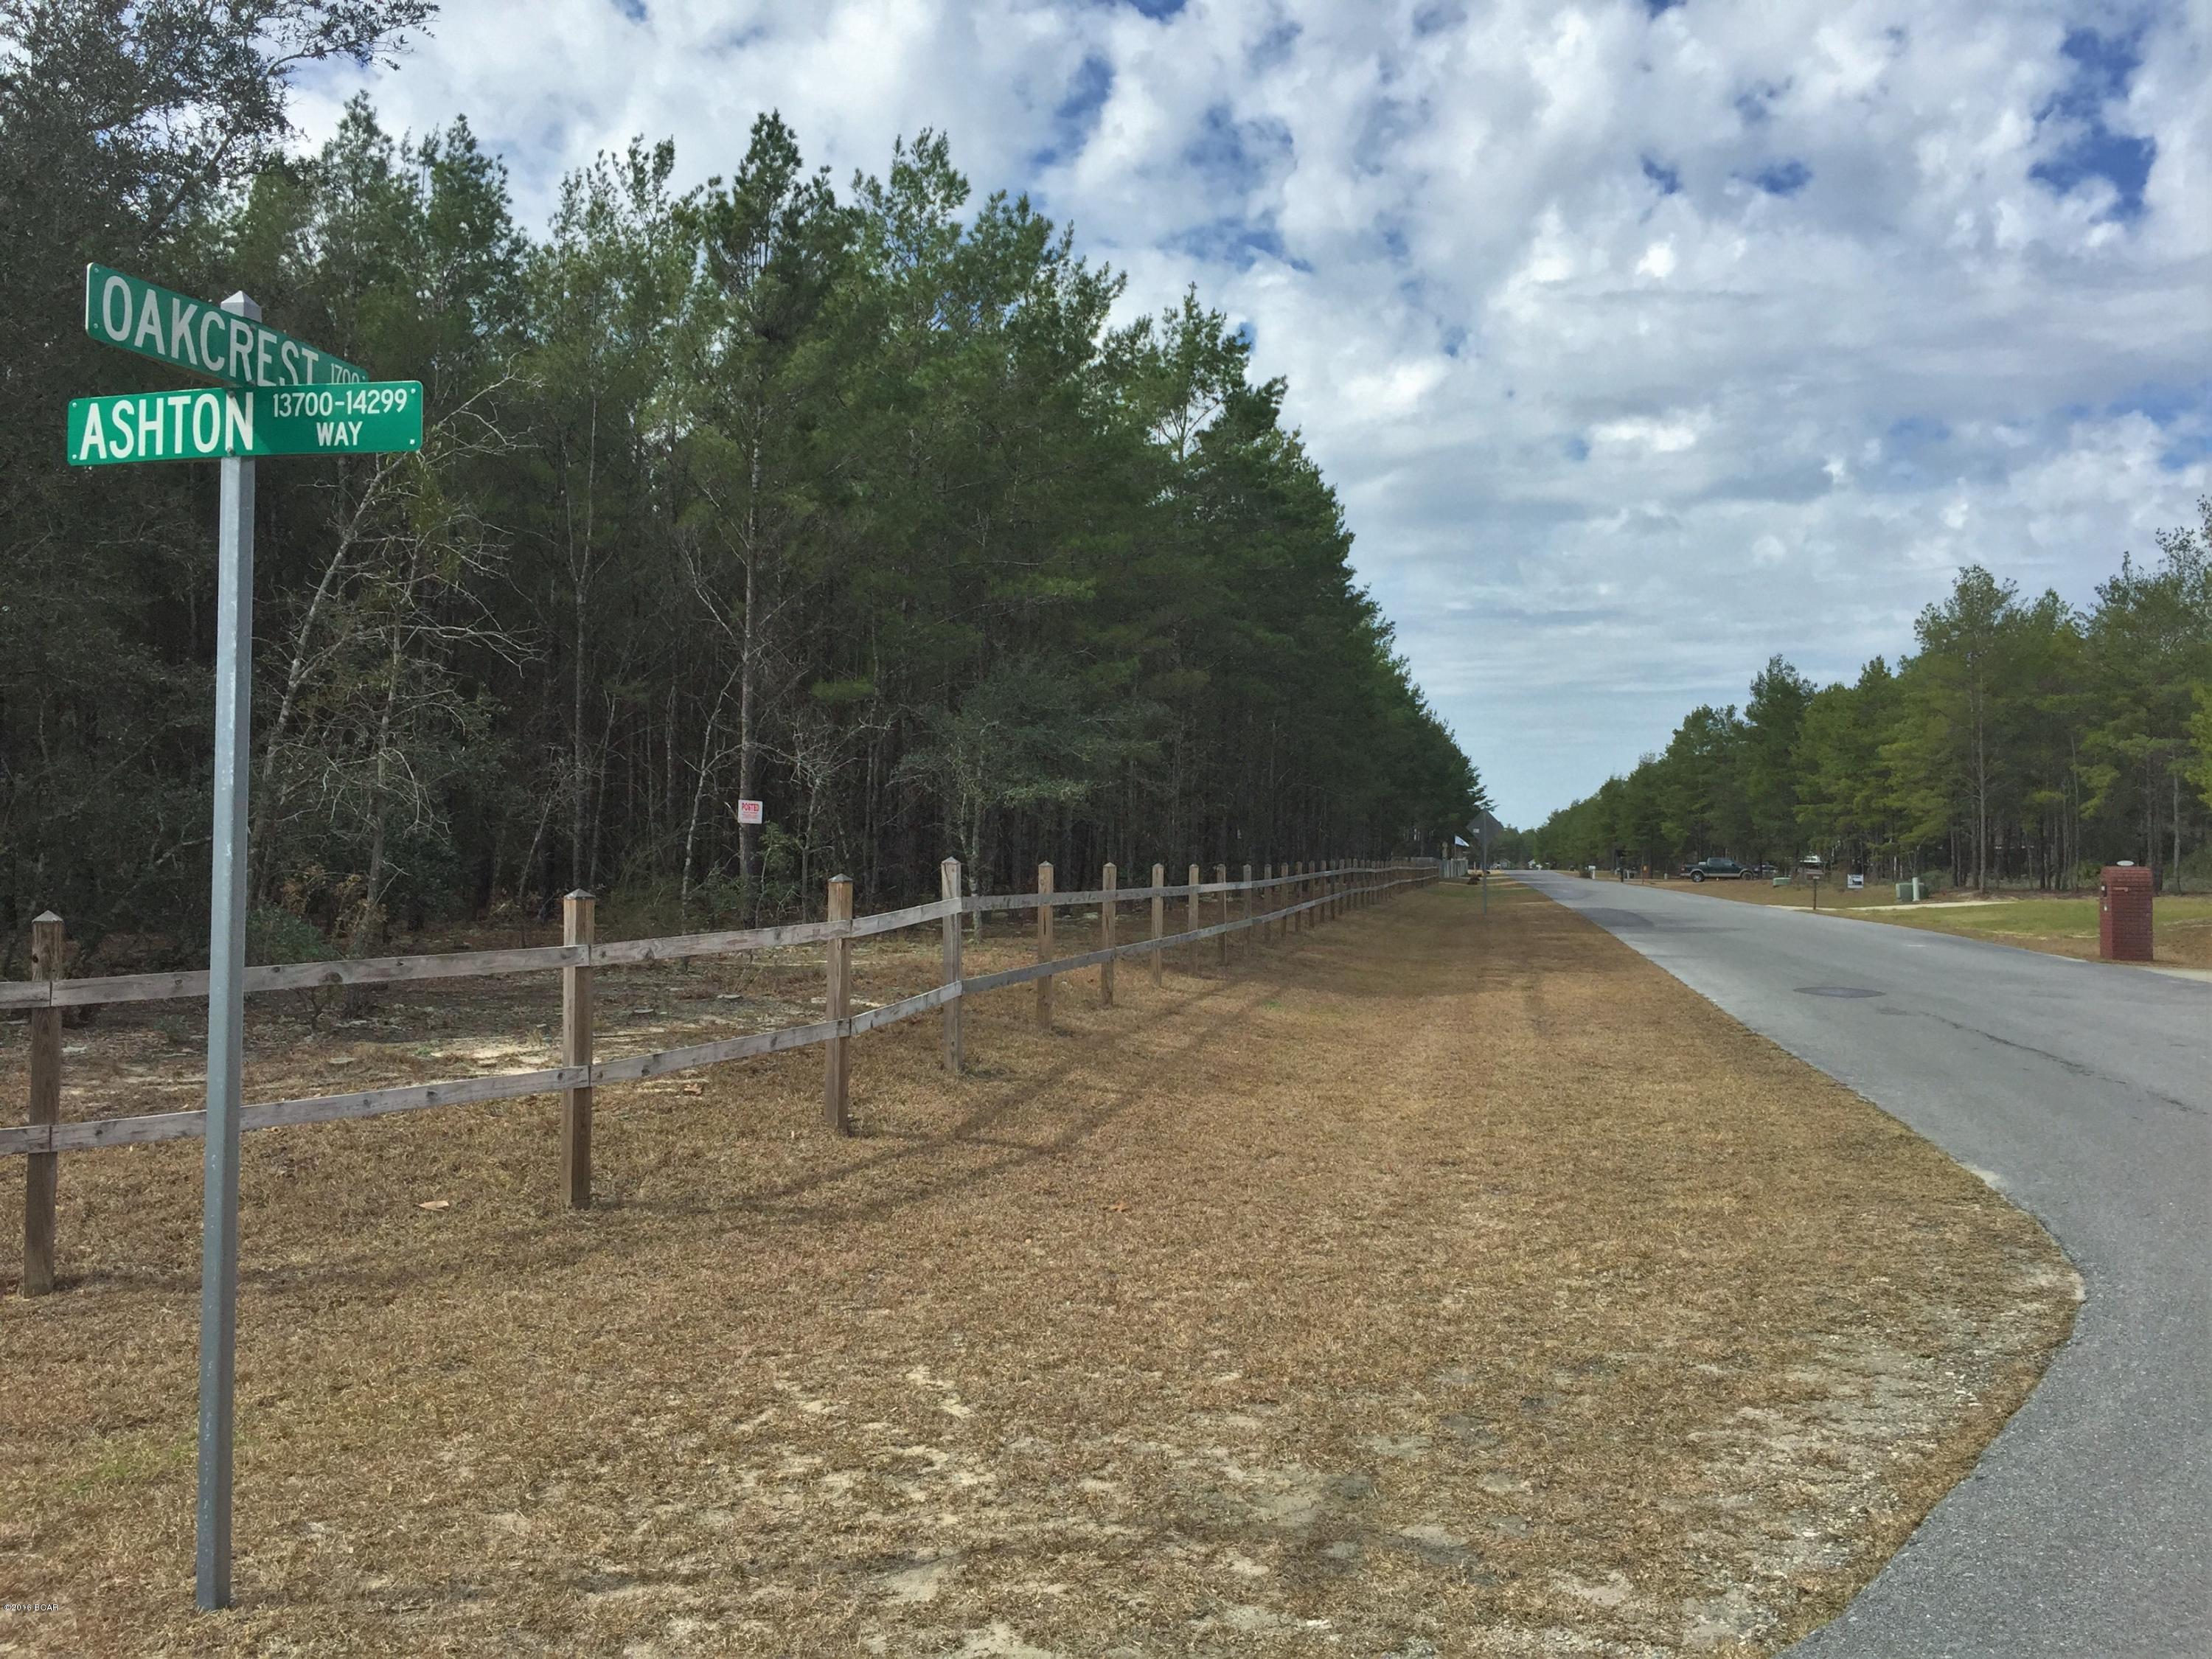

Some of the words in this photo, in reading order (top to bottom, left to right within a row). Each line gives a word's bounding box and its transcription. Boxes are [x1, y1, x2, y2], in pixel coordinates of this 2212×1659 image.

[102, 276, 319, 386] OAKCREST
[79, 392, 254, 460] ASHTON
[273, 389, 407, 417] 13700-14299
[316, 421, 363, 446] WAY
